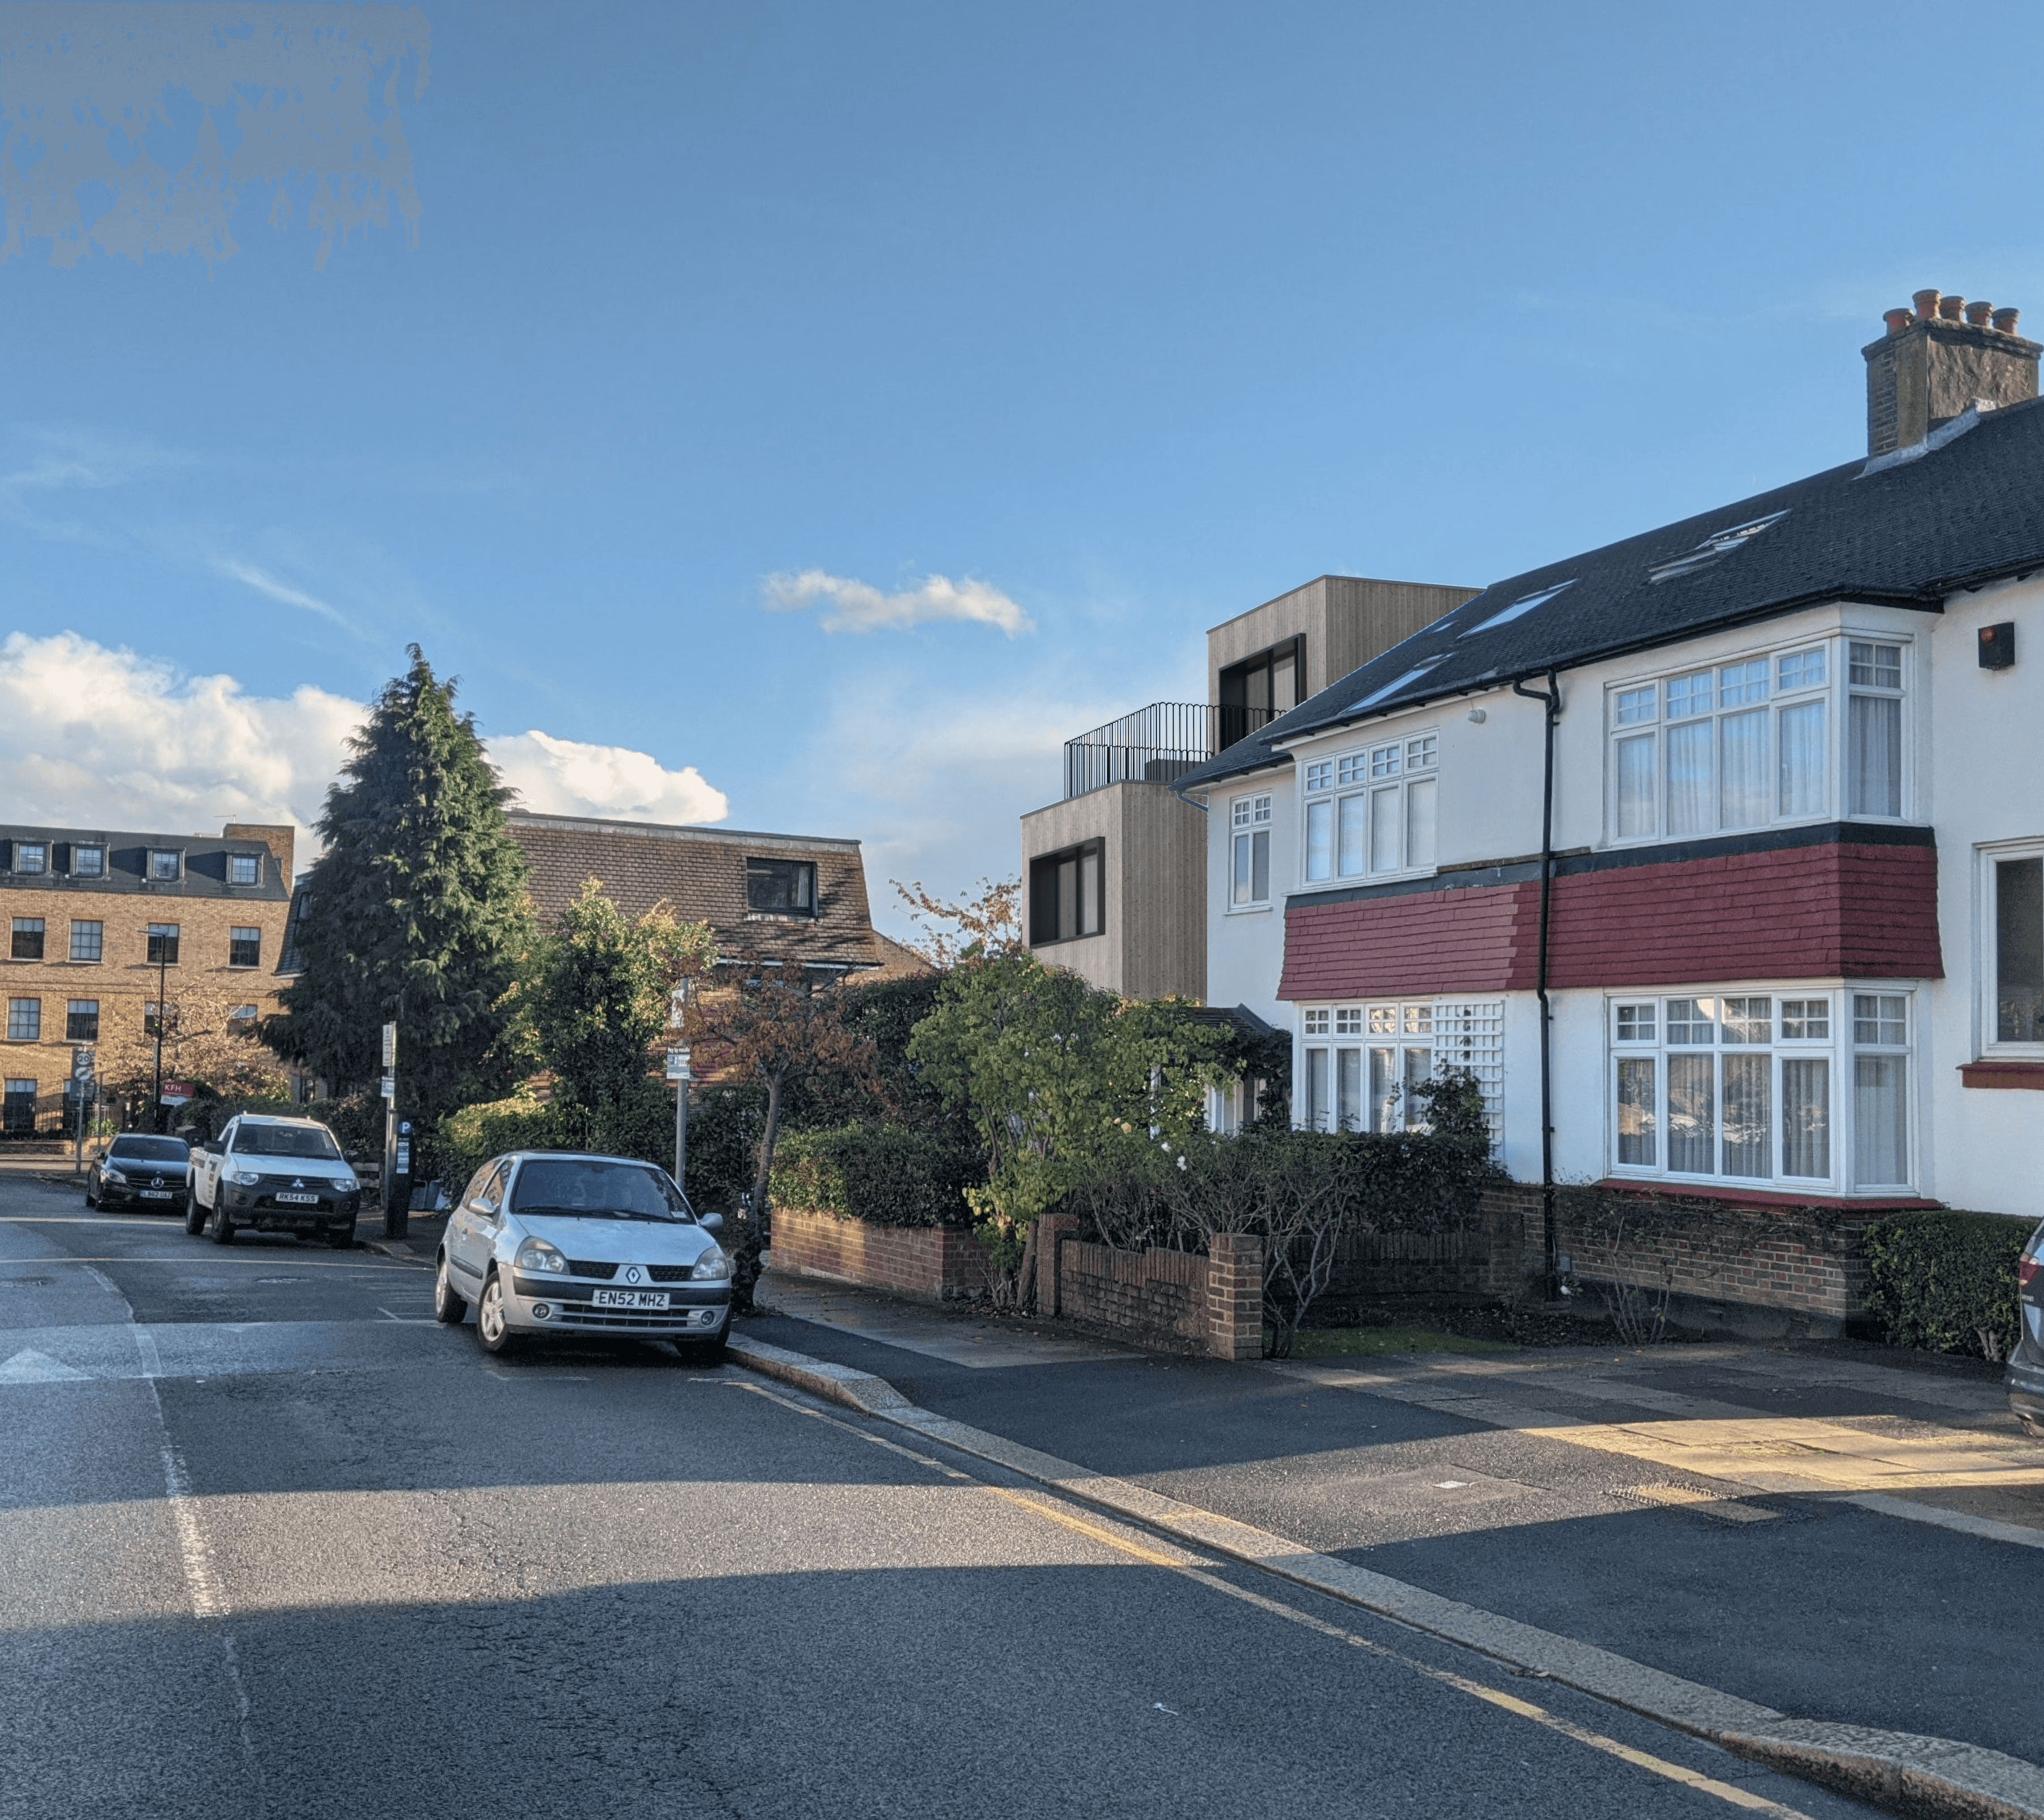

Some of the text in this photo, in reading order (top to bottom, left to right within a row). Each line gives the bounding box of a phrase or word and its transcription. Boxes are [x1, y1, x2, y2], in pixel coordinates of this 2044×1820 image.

[165, 1084, 182, 1092] KFH
[401, 1122, 410, 1133] P
[599, 1291, 665, 1306] EN52 MHZ
